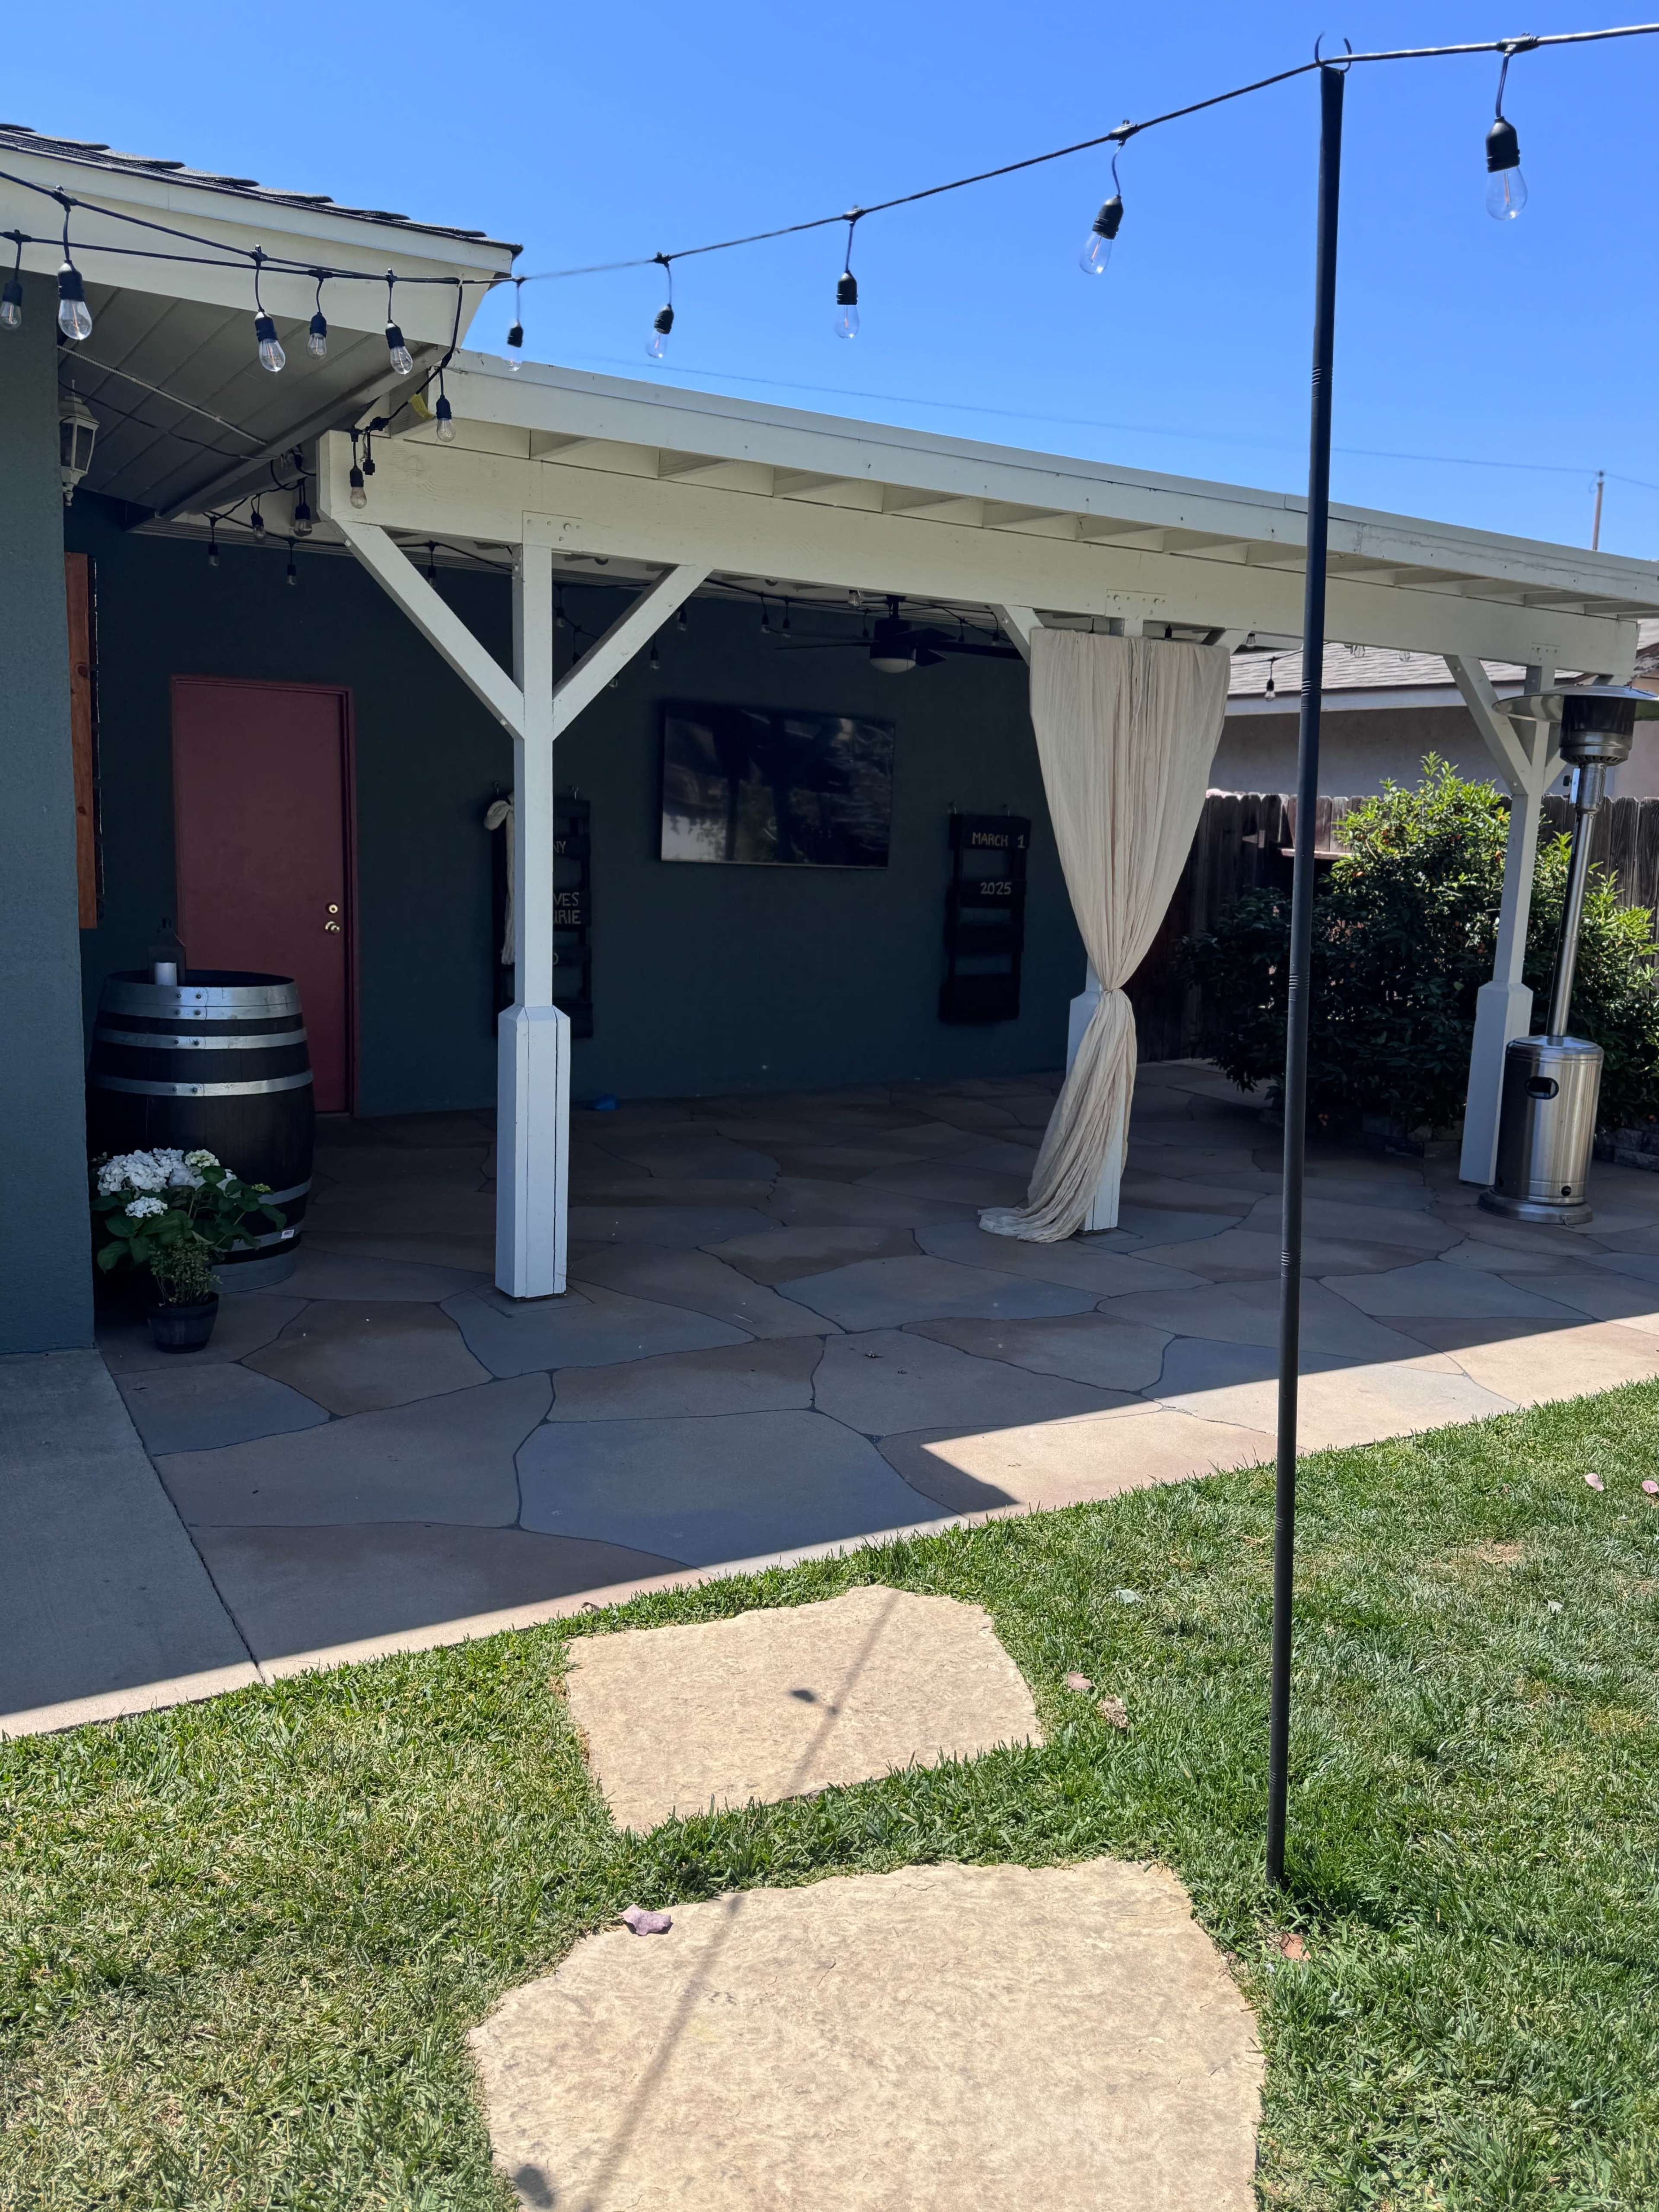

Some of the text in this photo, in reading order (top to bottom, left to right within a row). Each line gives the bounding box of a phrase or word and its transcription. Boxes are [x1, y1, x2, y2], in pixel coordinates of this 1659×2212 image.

[972, 832, 1025, 849] MARCH 1
[980, 881, 1012, 895] 2025
[553, 892, 579, 907] VES
[553, 910, 581, 924] RIE
